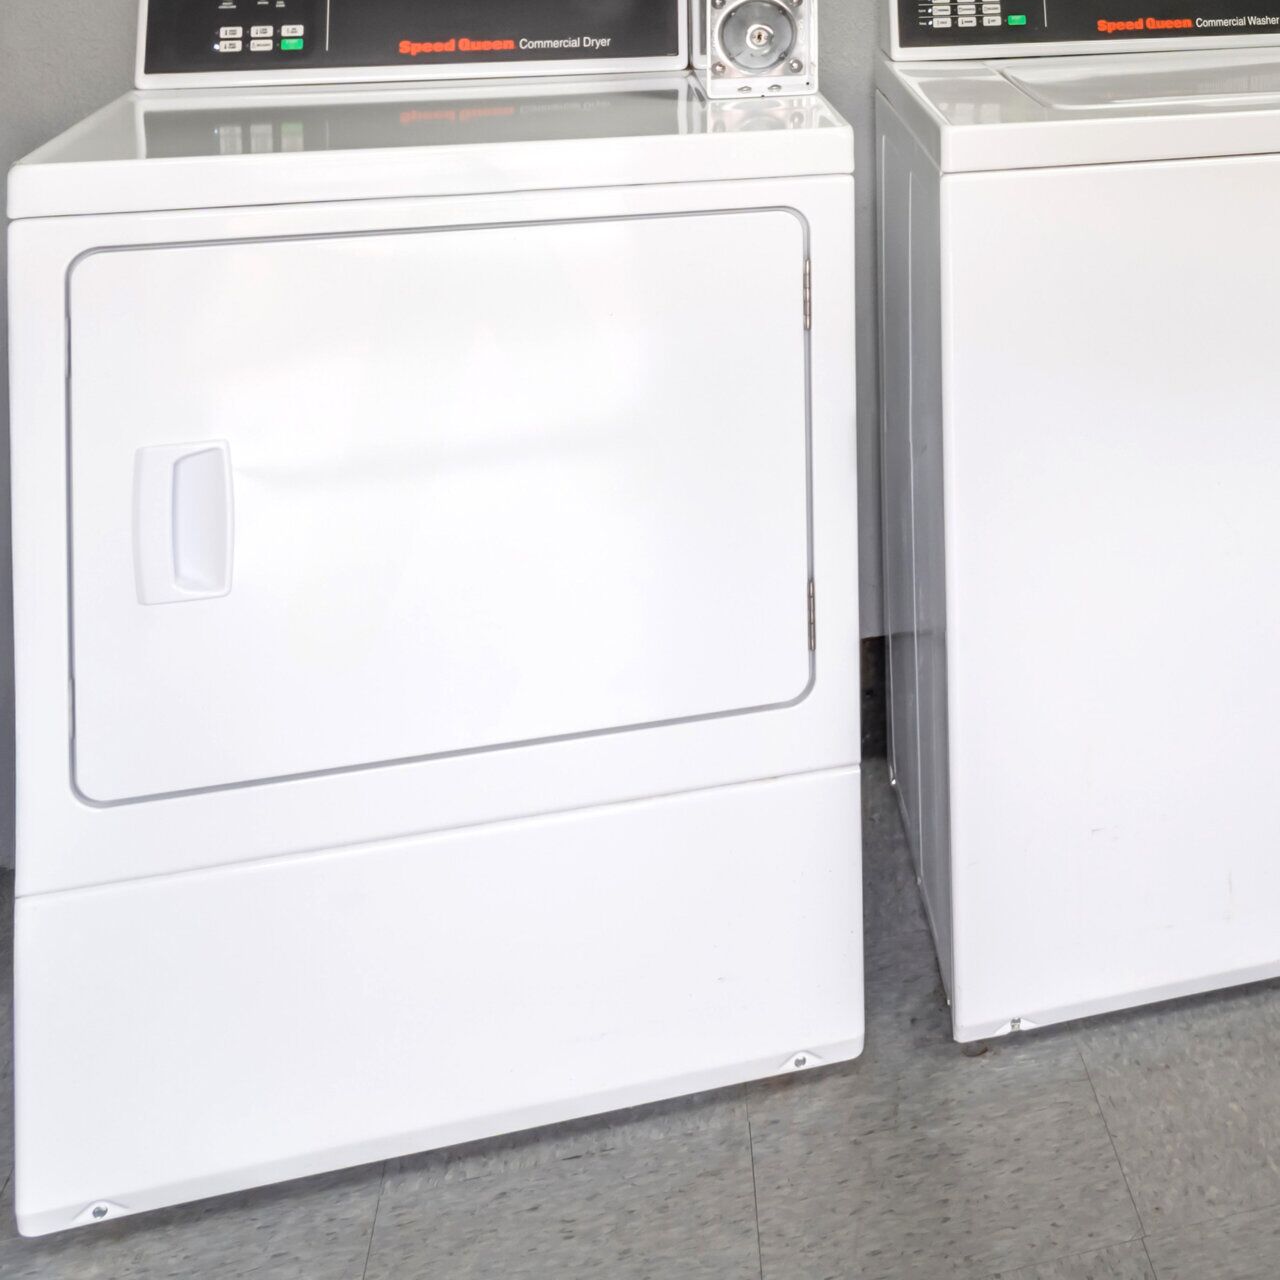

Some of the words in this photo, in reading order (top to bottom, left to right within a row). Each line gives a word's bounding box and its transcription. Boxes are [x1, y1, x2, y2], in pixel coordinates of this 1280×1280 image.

[1097, 19, 1144, 33] Speed
[1145, 18, 1193, 30] Queen
[1195, 16, 1246, 28] Commercial
[1247, 16, 1280, 26] Washer
[399, 38, 455, 56] Speed
[458, 38, 515, 51] Queen
[519, 36, 580, 50] Commercial
[583, 36, 611, 50] Dryer
